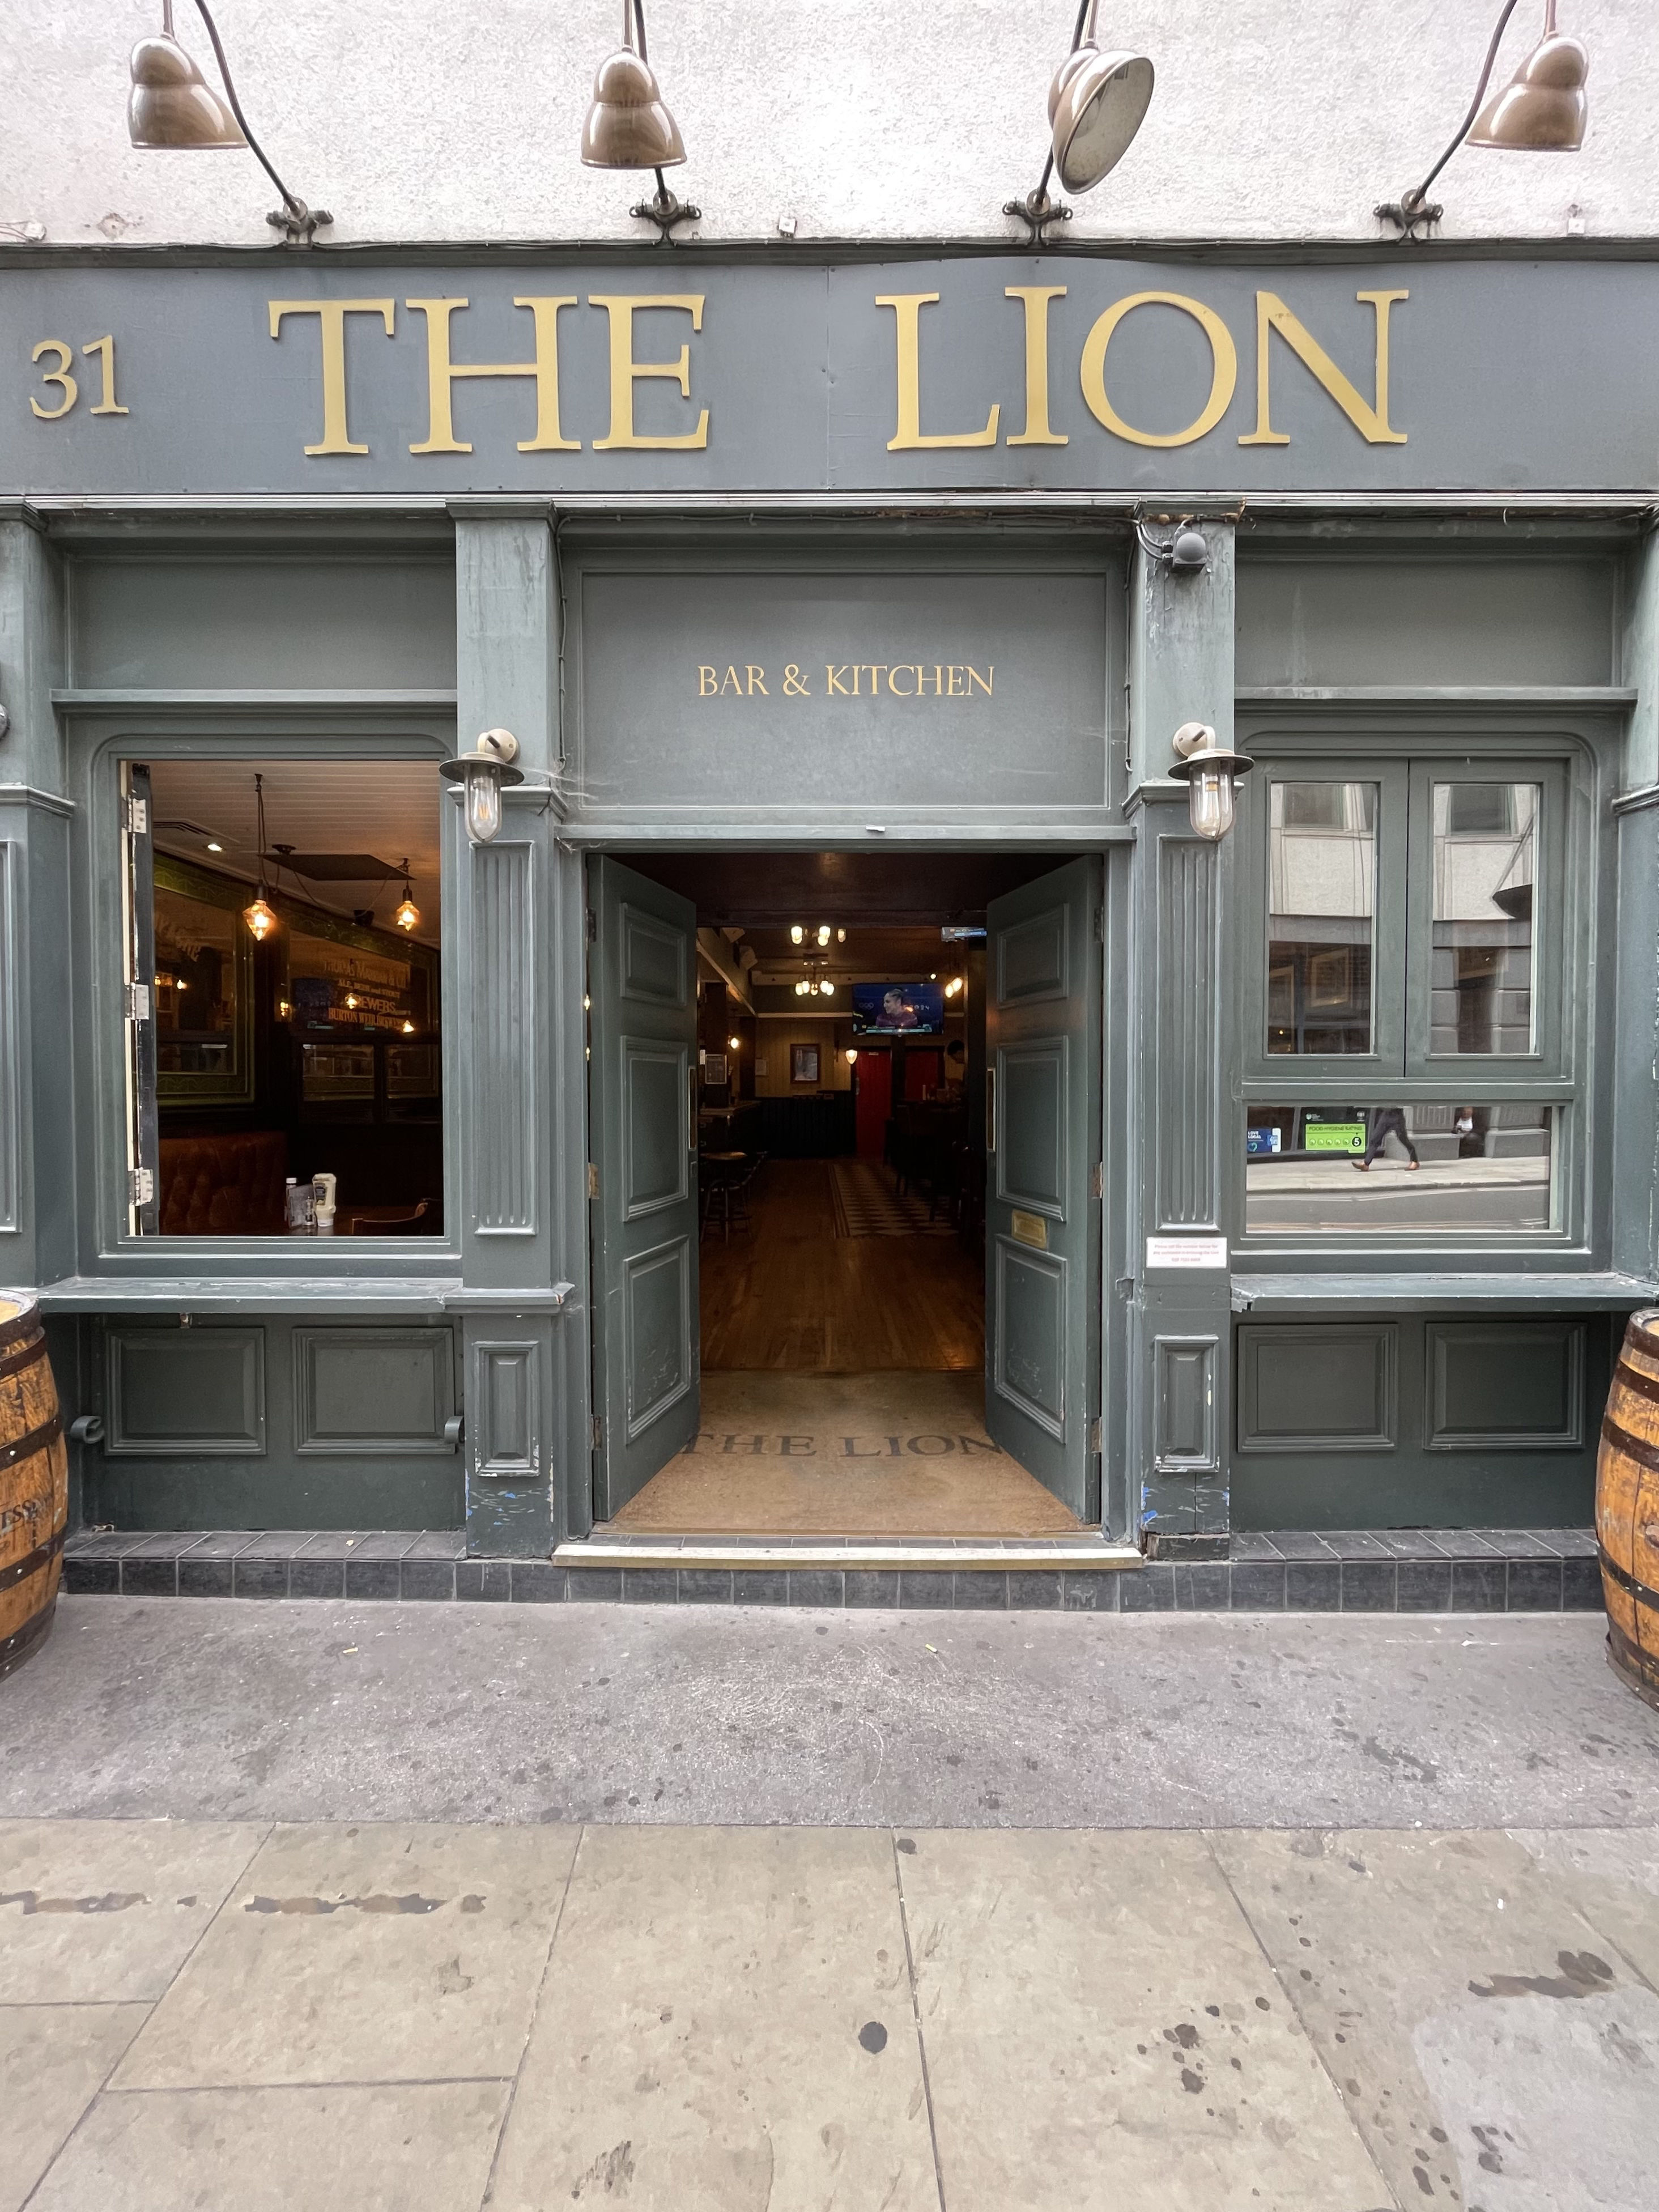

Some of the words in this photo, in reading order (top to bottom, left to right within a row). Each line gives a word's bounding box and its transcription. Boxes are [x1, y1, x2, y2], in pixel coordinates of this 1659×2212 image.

[29, 334, 129, 418] 31
[268, 295, 710, 456] THE
[875, 286, 1409, 450] LION
[697, 665, 770, 696] BAR
[782, 663, 811, 696] &
[825, 665, 995, 696] KITCHEN
[1354, 1138, 1360, 1146] 5
